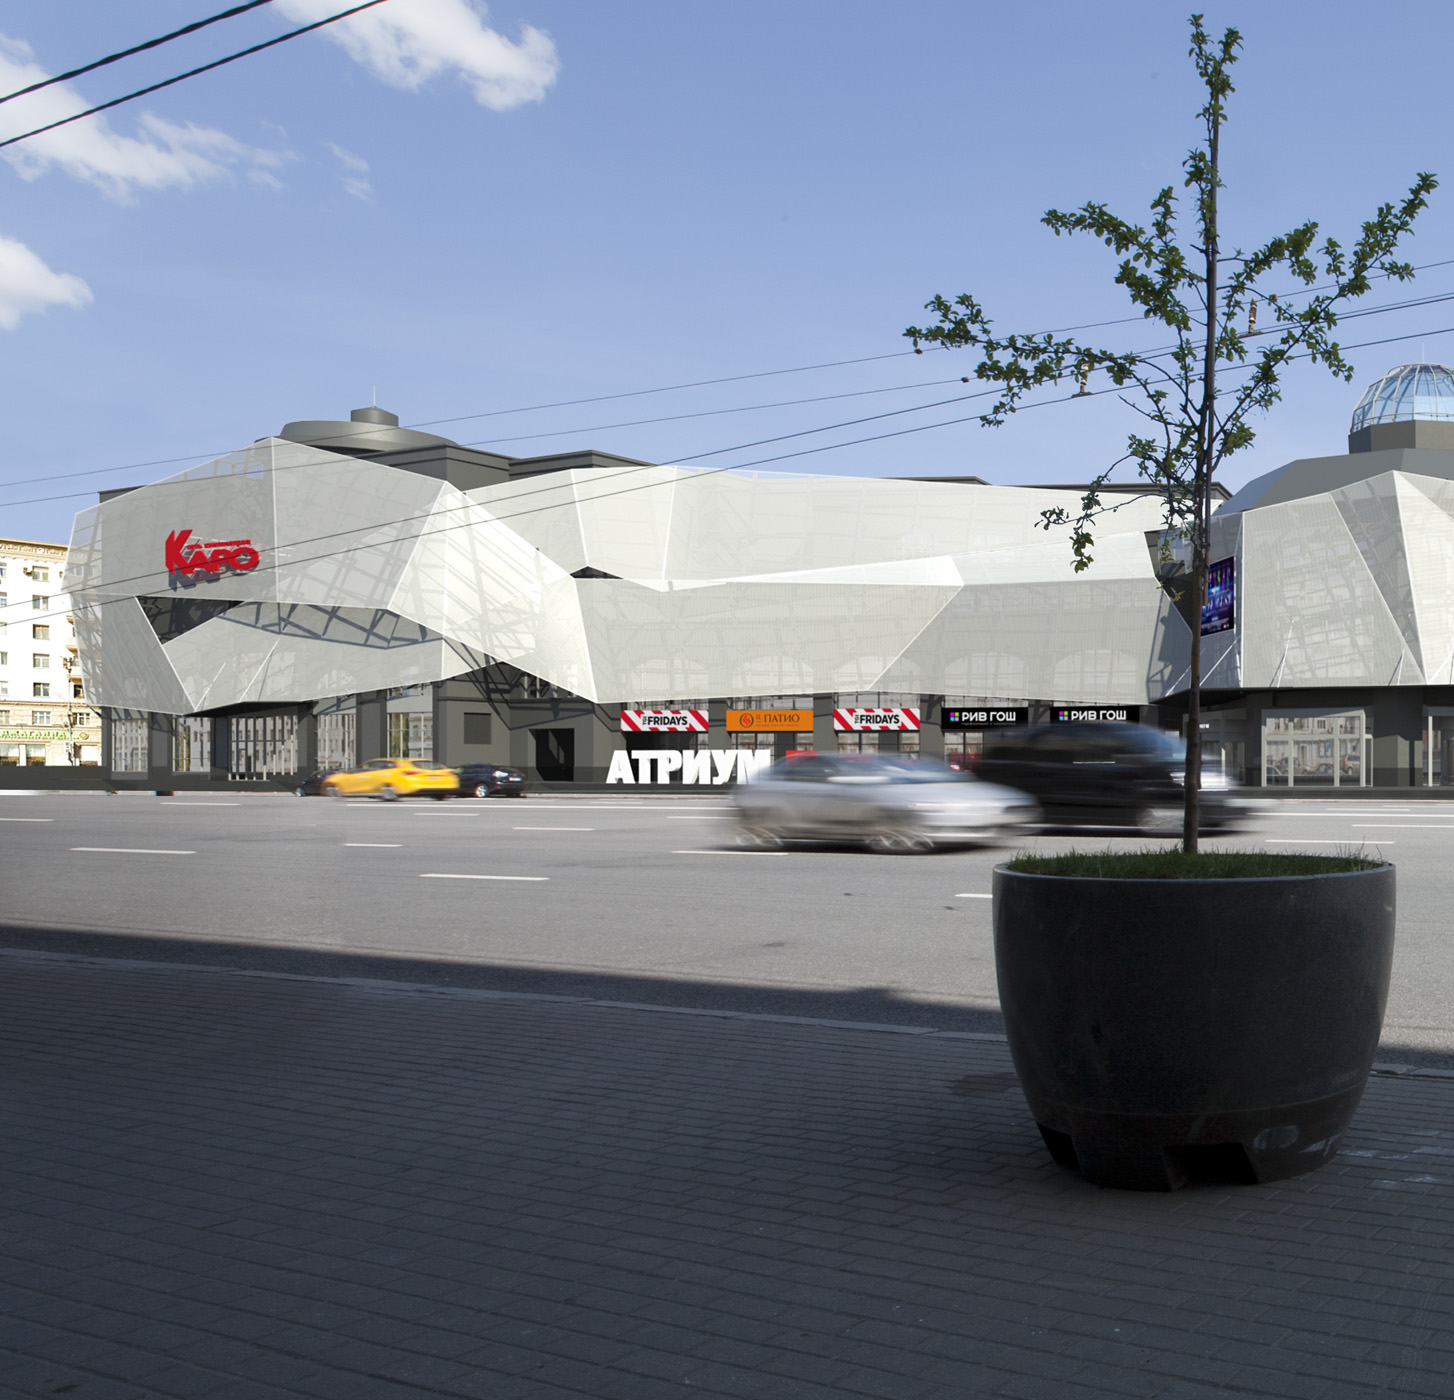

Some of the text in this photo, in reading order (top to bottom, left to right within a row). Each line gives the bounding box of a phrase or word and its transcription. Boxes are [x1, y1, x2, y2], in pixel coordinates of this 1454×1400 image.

[165, 529, 260, 576] КАРО
[647, 716, 688, 726] FRIDAYS
[764, 714, 800, 723] ПАТИО
[859, 714, 900, 724] FRIDAYS
[961, 711, 1016, 722] РИВ ГОШ
[1070, 710, 1126, 721] РИВ ГОШ
[605, 749, 771, 785] АТРИУМ
